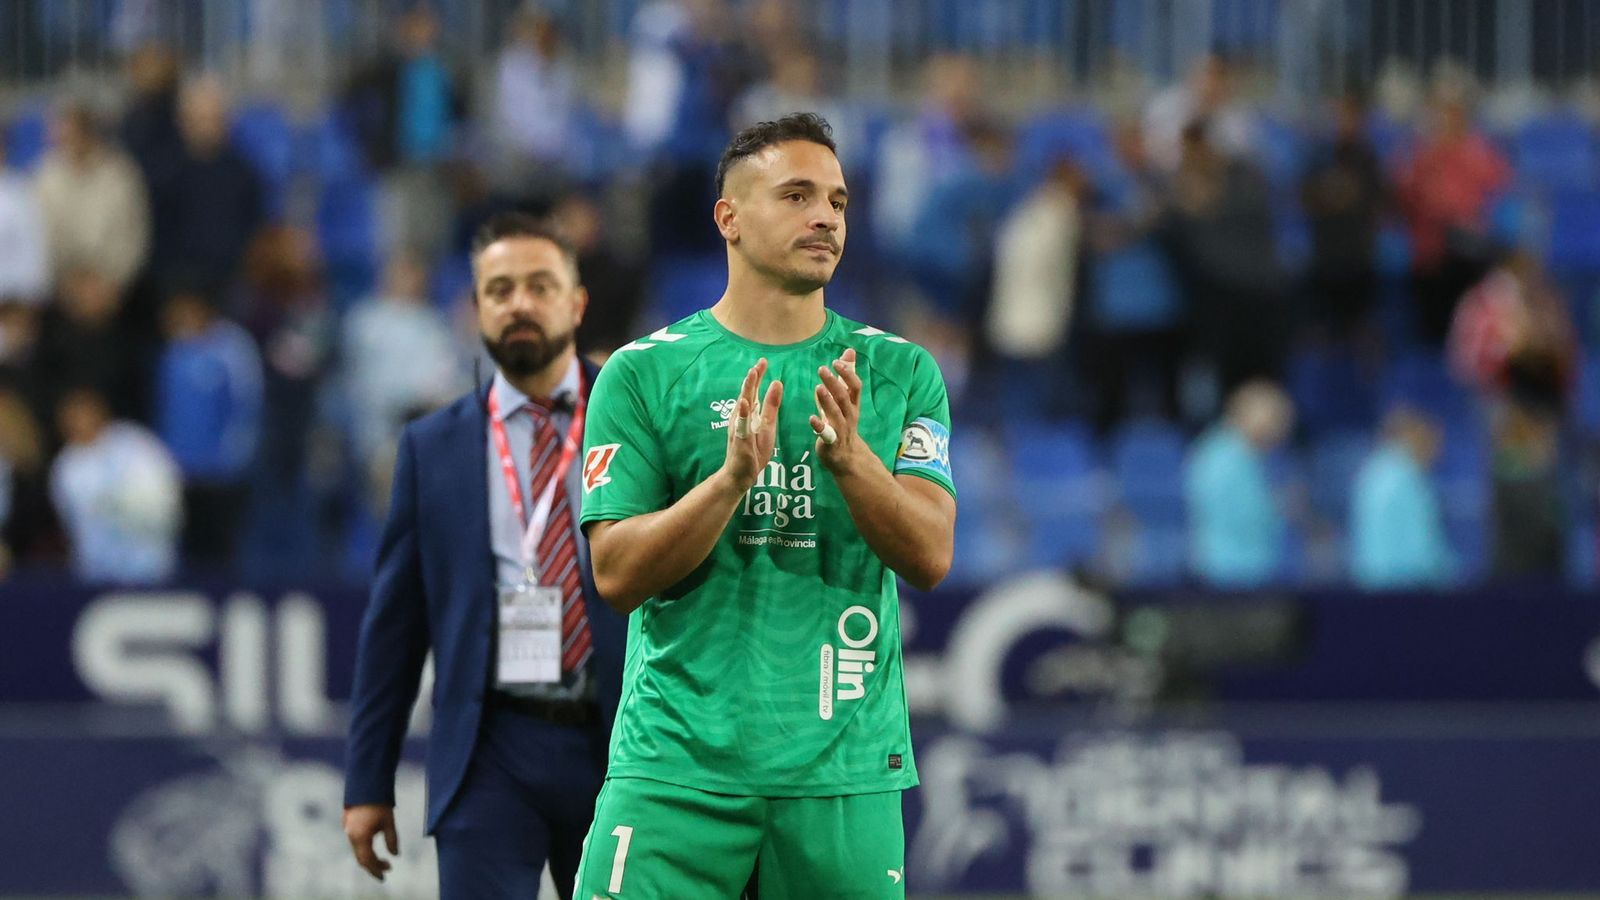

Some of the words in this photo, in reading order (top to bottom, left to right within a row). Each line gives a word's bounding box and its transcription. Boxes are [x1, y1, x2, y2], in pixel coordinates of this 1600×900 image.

[753, 450, 816, 491] má
[742, 487, 815, 528] laga
[738, 535, 767, 545] Málaga
[777, 536, 816, 548] Provincia
[823, 650, 831, 669] fibra
[837, 605, 878, 700] Olin
[608, 825, 634, 894] 1
